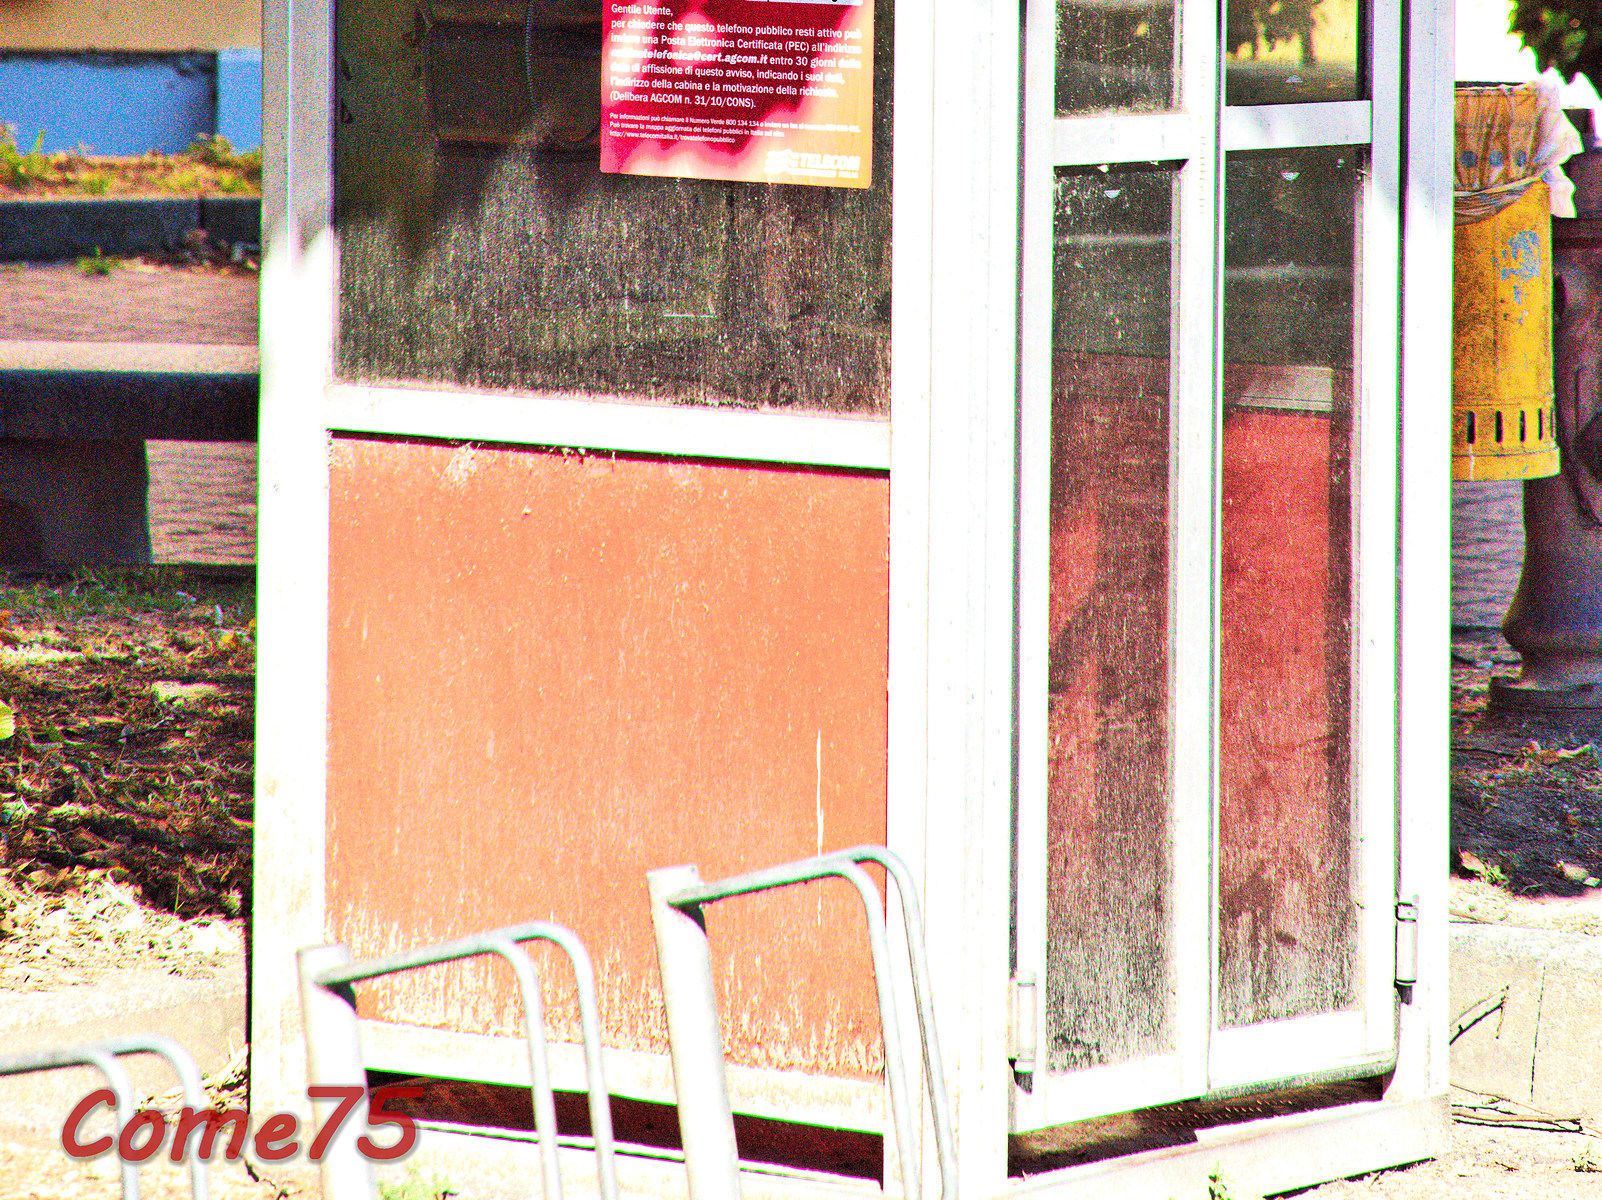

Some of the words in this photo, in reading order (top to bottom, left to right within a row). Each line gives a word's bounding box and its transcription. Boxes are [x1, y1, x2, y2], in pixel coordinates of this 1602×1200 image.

[611, 4, 642, 15] Gentile
[643, 5, 674, 17] Utente,
[611, 20, 626, 29] per
[667, 21, 683, 31] che
[685, 23, 715, 33] questo
[717, 24, 753, 34] telefono
[755, 26, 793, 36] pubblico
[795, 27, 815, 37] resti
[817, 28, 842, 38] attivo
[642, 36, 659, 44] una
[661, 35, 687, 46] Posta
[688, 36, 735, 48] Elettronica
[737, 39, 783, 50] Certificata
[785, 41, 810, 53] (PEC)
[769, 57, 793, 66] entro
[795, 57, 808, 66] 30
[810, 58, 837, 69] giorni
[641, 64, 683, 75] affissione
[685, 66, 693, 76] di
[695, 68, 724, 79] questo
[726, 69, 755, 80] avviso,
[756, 70, 799, 81] indicando
[805, 72, 824, 82] suoi
[651, 79, 672, 89] della
[674, 81, 702, 91] cabina
[704, 83, 711, 91] e
[712, 82, 720, 91] la
[722, 84, 774, 95] motivazione
[776, 85, 797, 96] della
[610, 90, 649, 103] (Delibera
[650, 93, 683, 104] AGCOM
[684, 95, 693, 105] n.
[694, 95, 756, 110] 31/10/CONS).
